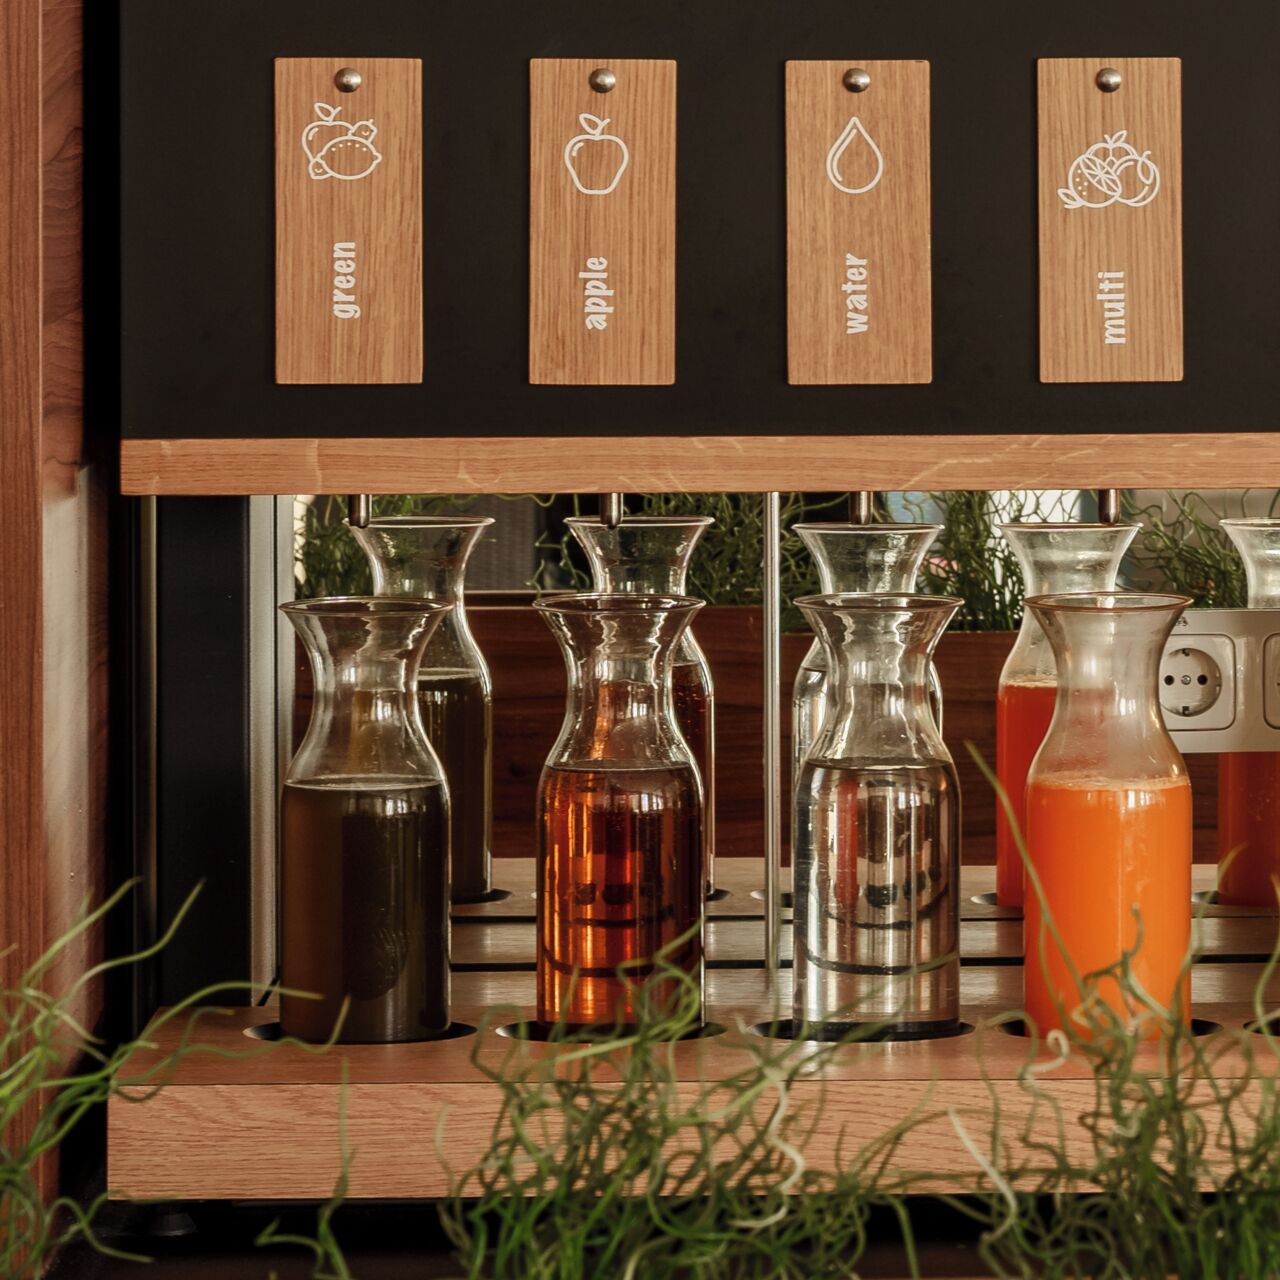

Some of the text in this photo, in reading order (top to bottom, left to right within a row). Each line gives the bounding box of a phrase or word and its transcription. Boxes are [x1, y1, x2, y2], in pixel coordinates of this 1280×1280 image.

[333, 242, 361, 319] green
[580, 257, 613, 330] apple
[842, 253, 868, 334] water
[1097, 271, 1126, 344] multi
